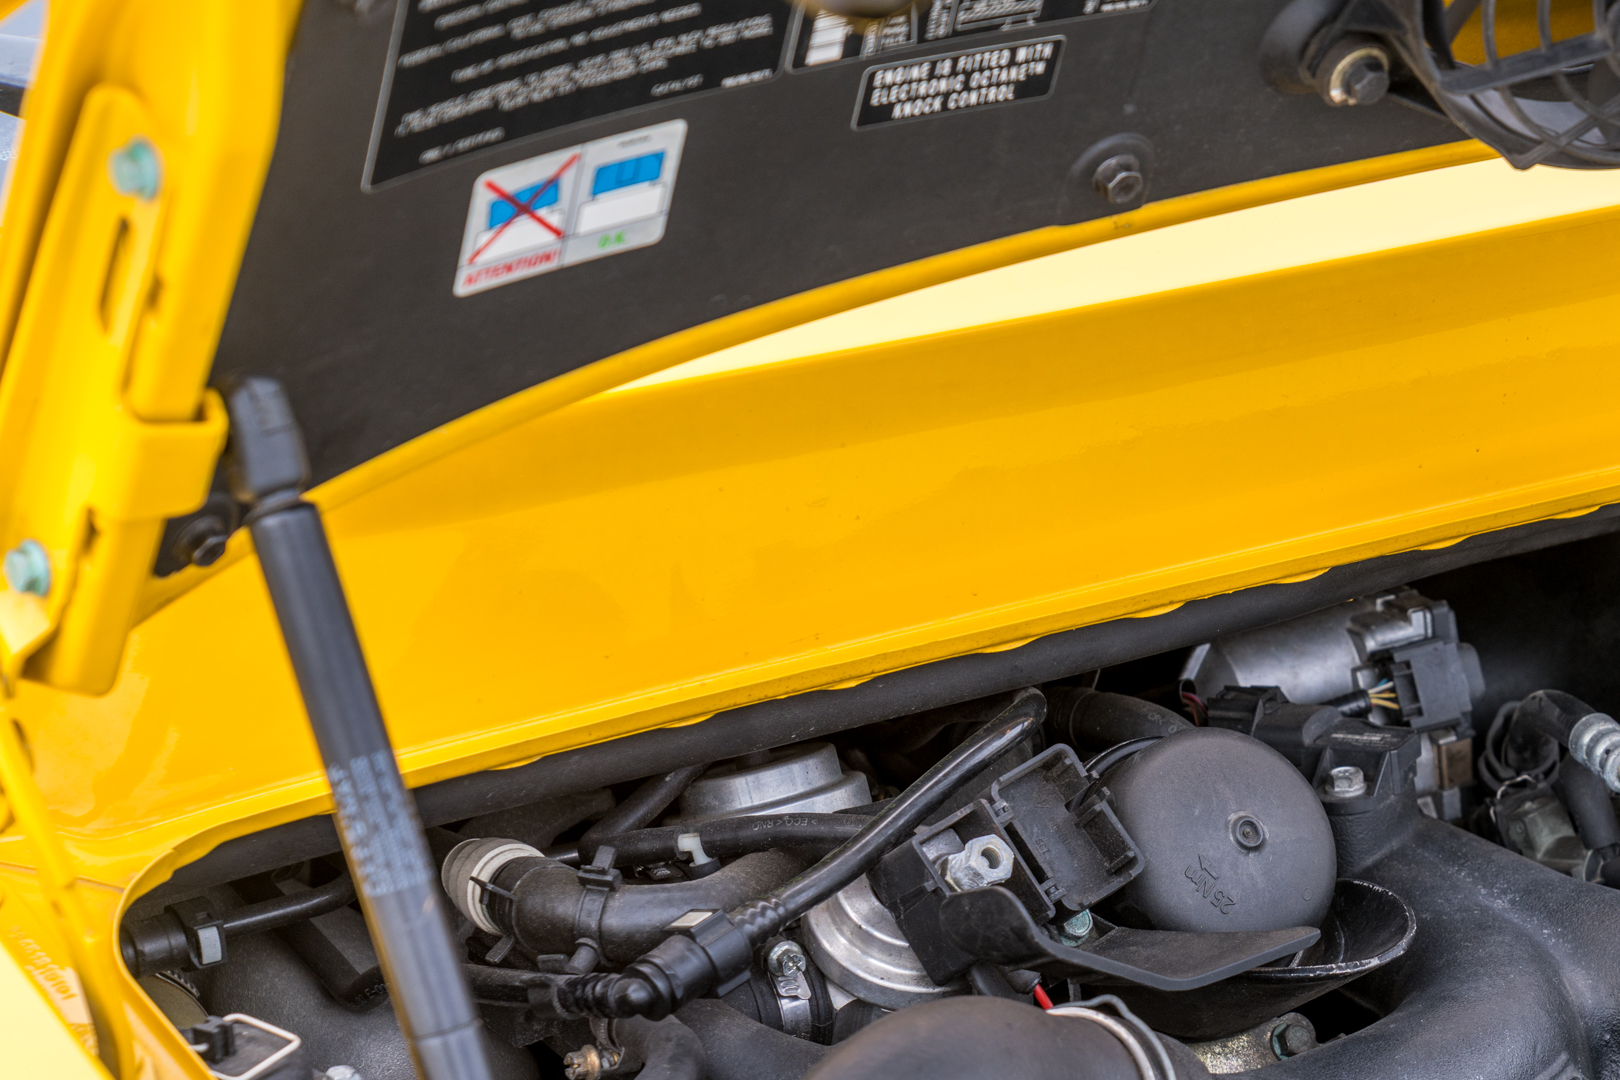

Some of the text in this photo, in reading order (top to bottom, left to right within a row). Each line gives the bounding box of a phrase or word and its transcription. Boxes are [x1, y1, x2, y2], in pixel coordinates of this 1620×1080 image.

[873, 41, 1054, 87] ENGINE IS FITTED WITH
[870, 75, 965, 105] ELECTRONIC
[892, 83, 1016, 119] KNOCK CONTROL
[461, 249, 560, 287] ATTENTION!
